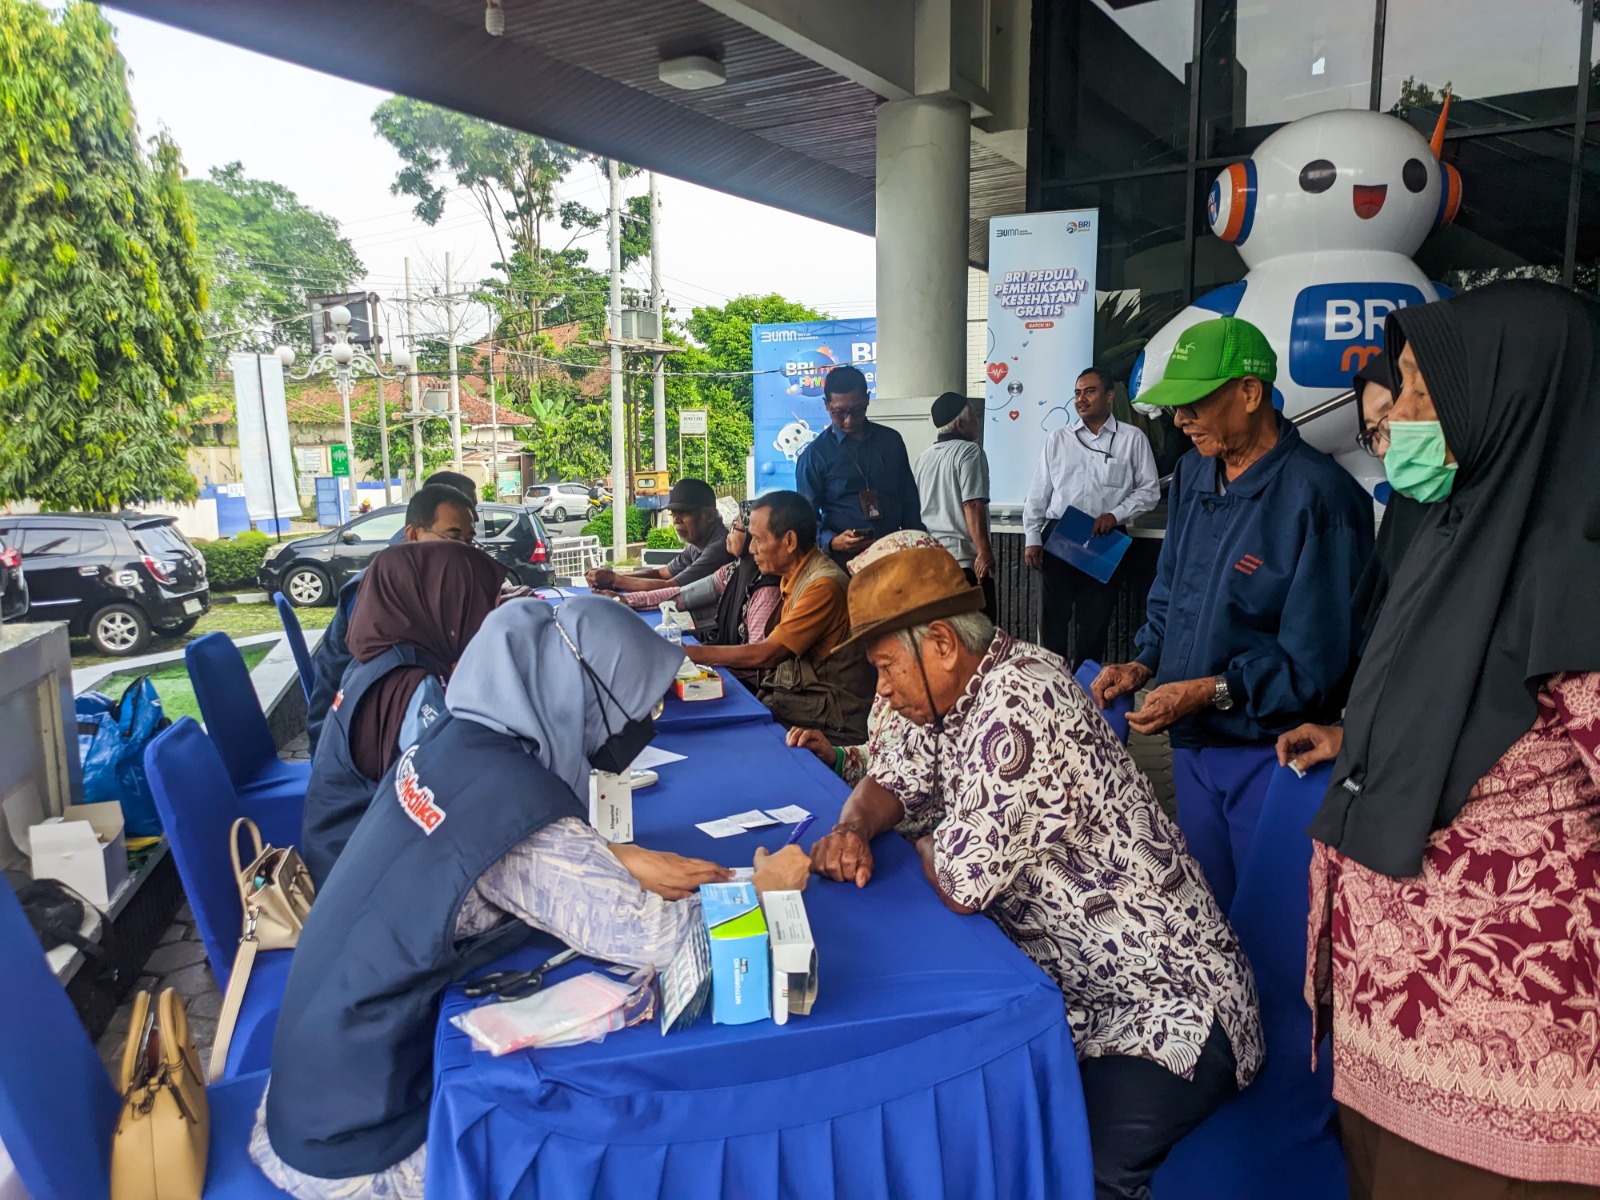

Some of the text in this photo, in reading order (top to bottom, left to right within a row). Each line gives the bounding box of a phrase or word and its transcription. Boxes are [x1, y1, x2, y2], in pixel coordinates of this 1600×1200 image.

[1005, 268, 1075, 283] BRI PEDULI
[994, 279, 1087, 295] PEMERIKSAAN
[1001, 291, 1077, 306] KESEHATAN
[1015, 303, 1063, 317] GRATIS
[1325, 299, 1407, 340] BR
[785, 361, 838, 376] BRIm
